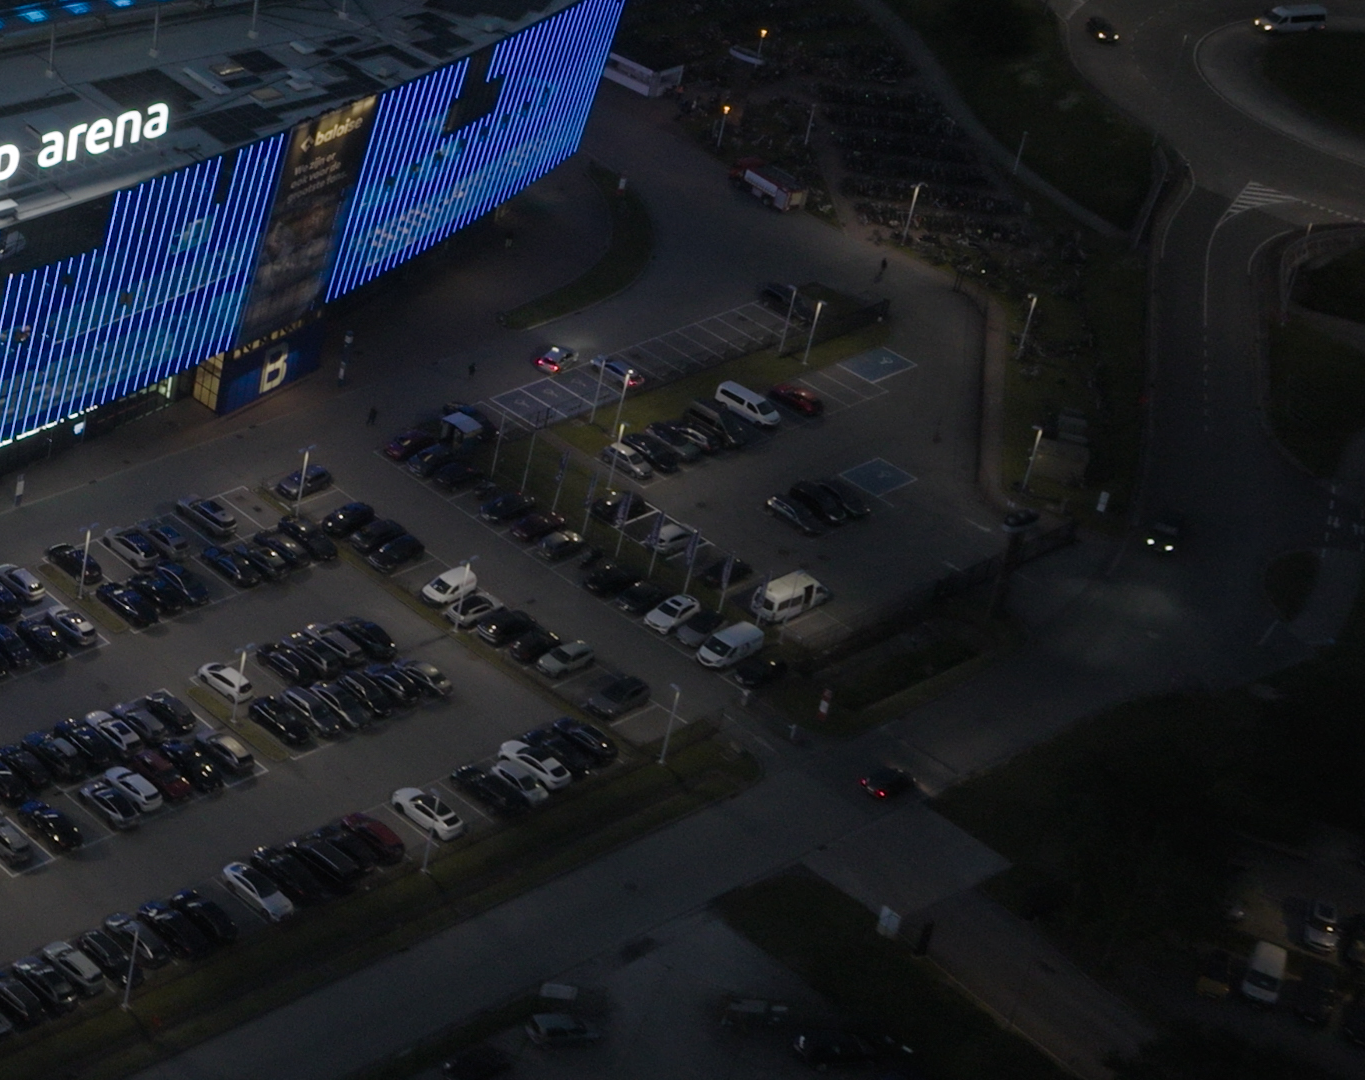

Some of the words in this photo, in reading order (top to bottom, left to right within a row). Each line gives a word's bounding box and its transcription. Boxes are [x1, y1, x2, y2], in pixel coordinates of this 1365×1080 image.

[37, 101, 170, 168] arena
[314, 117, 363, 147] baloise
[260, 344, 289, 394] B
